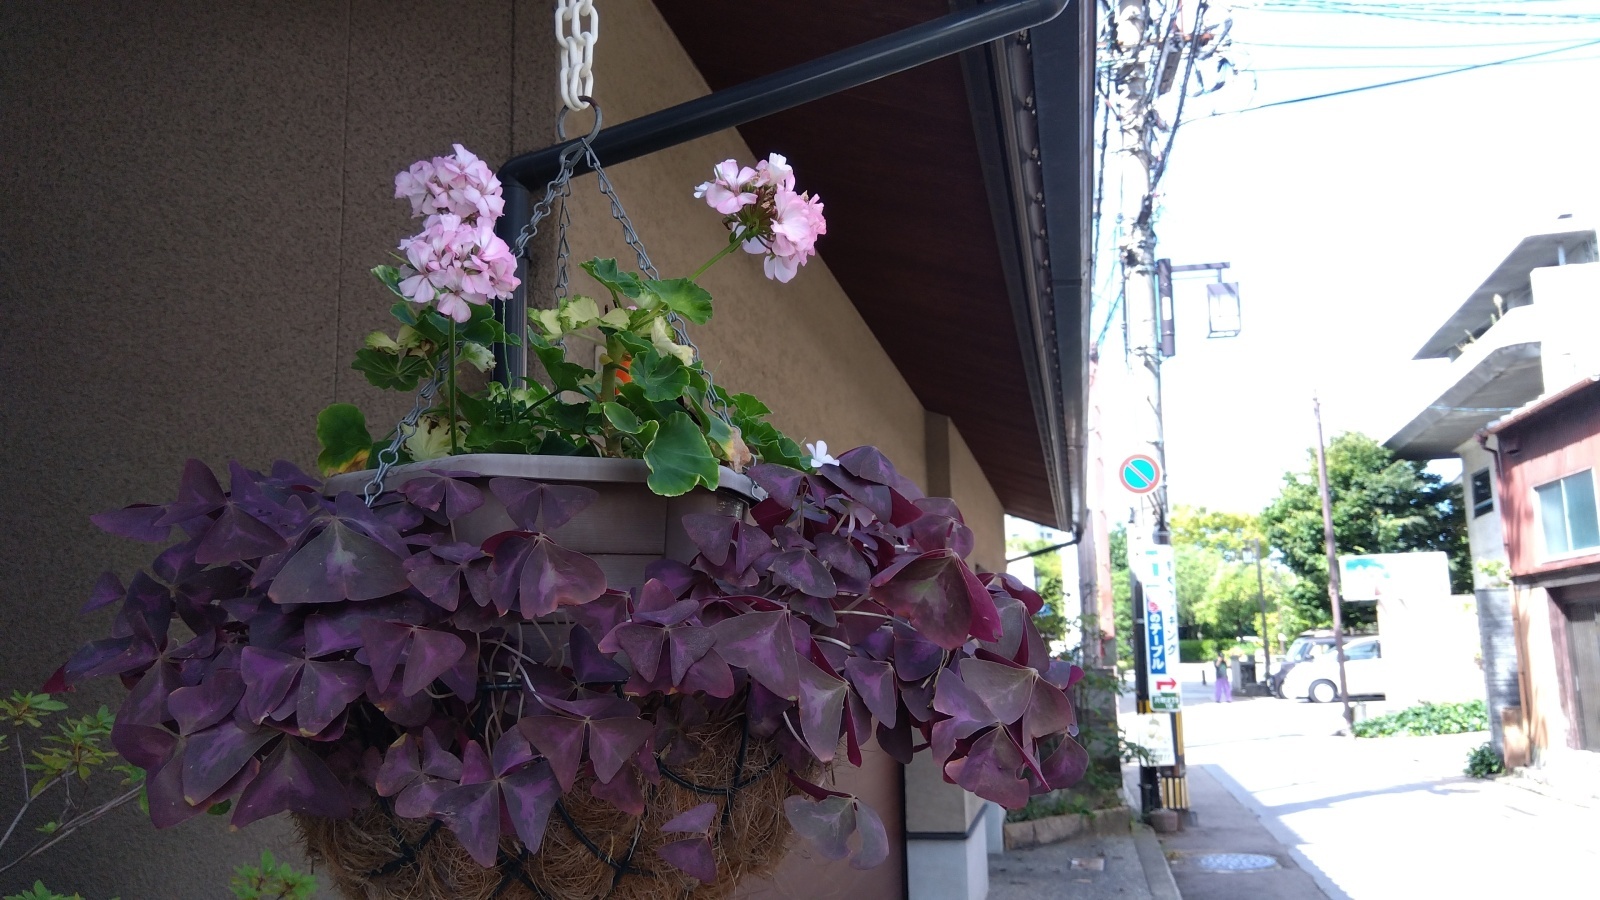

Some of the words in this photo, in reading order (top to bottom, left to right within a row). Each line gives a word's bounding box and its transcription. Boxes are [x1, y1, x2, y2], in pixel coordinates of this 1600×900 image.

[1149, 613, 1165, 670] のテーブル
